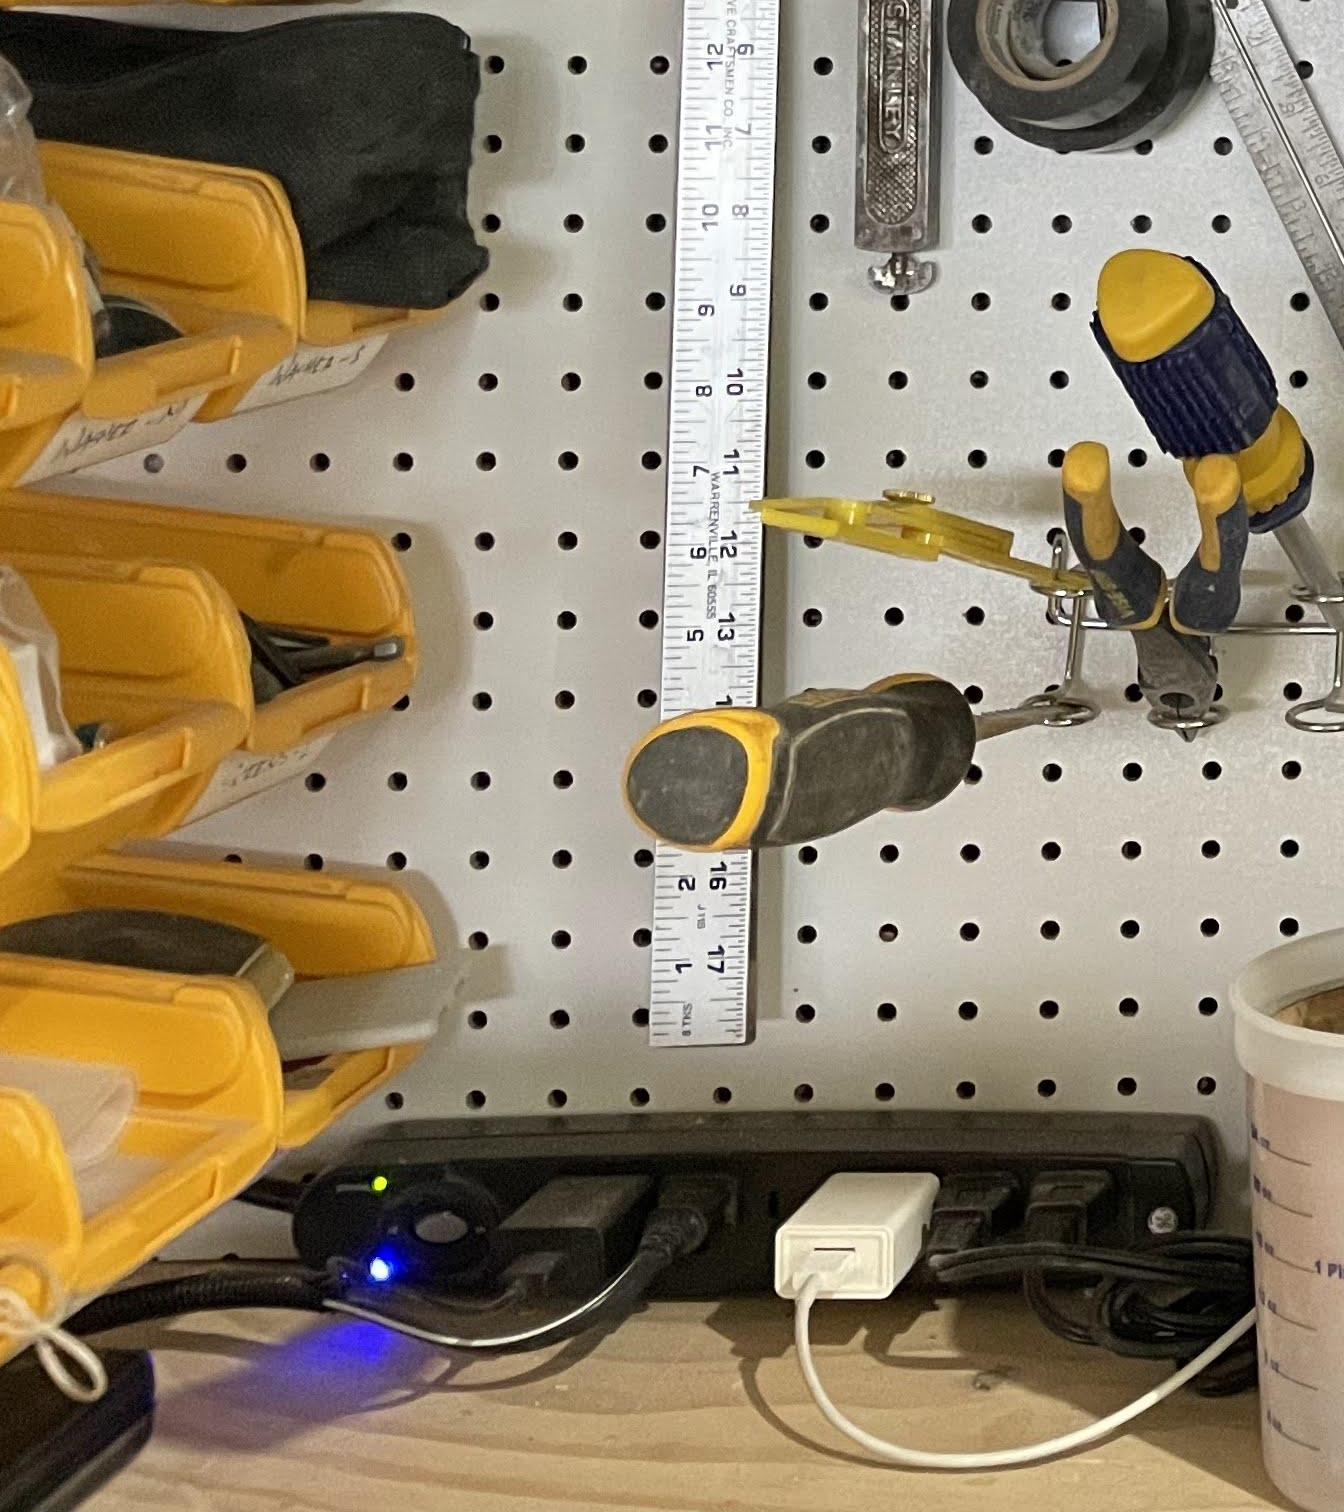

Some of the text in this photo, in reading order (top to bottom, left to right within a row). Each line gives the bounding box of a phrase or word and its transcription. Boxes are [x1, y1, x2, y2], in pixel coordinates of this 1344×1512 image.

[707, 43, 723, 71] 12
[737, 43, 754, 56] 6
[724, 19, 737, 96] CRAFTSMEN
[885, 3, 905, 143] STANLEY
[704, 123, 722, 151] 11
[734, 123, 751, 136] 7
[702, 203, 719, 232] 10
[731, 204, 749, 217] 8
[729, 284, 747, 297] 9
[698, 304, 715, 317] 9
[726, 368, 743, 396] 10
[695, 385, 713, 398] 8
[723, 448, 740, 476] 11
[692, 465, 710, 478] 7
[720, 529, 737, 559] 12
[690, 547, 707, 560] 6
[717, 612, 735, 642] 13
[686, 629, 704, 642] 5
[715, 694, 733, 707] 1
[709, 861, 727, 890] 16
[678, 877, 696, 892] 2
[707, 945, 725, 974] 17
[675, 963, 693, 974] 1
